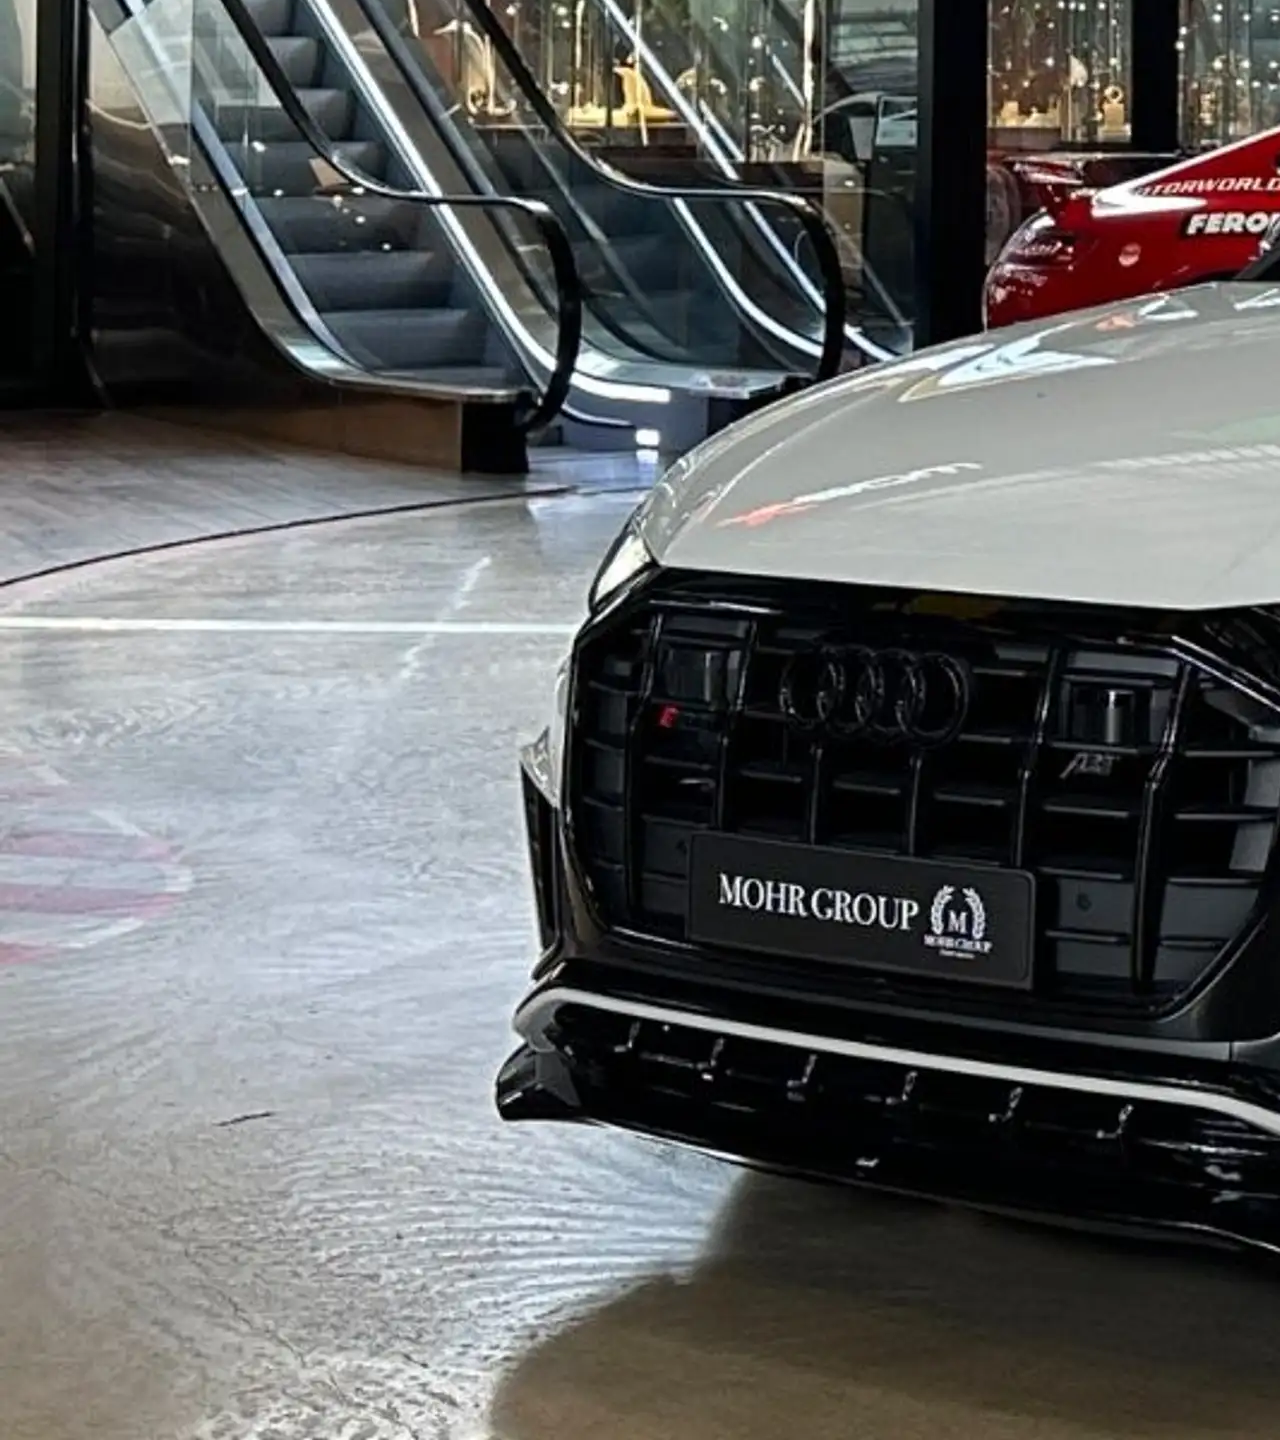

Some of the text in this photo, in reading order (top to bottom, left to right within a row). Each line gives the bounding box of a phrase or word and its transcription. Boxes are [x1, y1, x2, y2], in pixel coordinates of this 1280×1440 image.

[719, 872, 919, 930] MOHR GROUP
[948, 910, 967, 934] M
